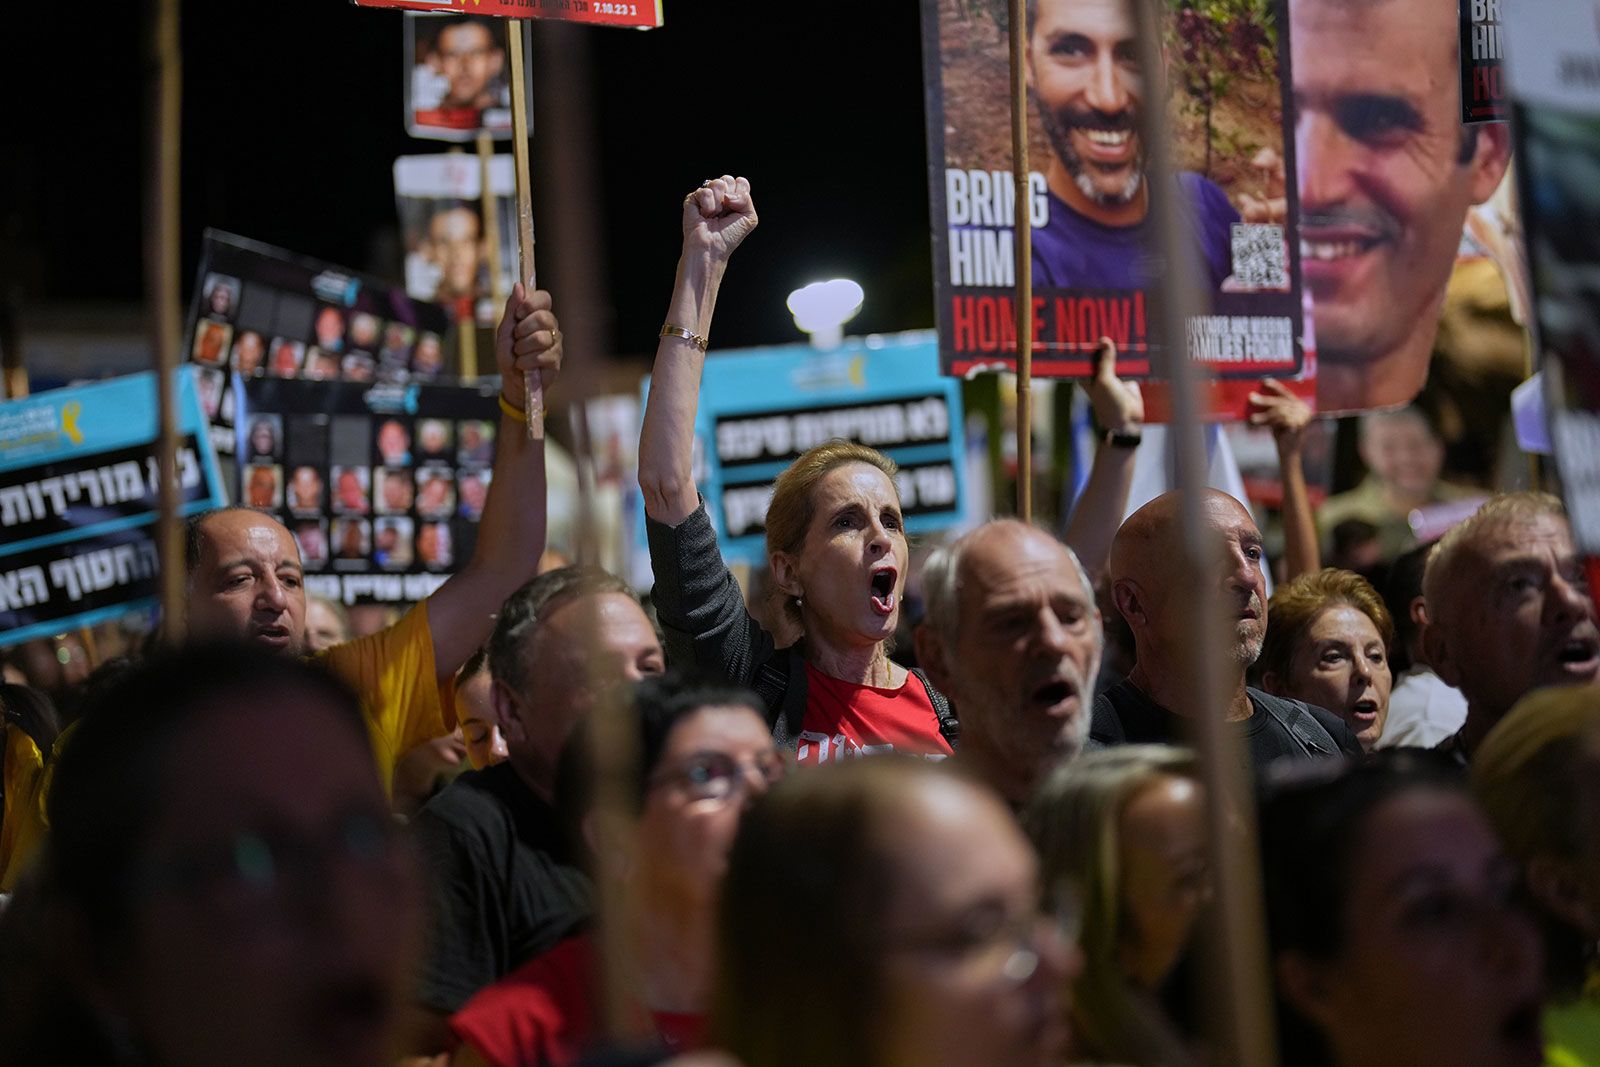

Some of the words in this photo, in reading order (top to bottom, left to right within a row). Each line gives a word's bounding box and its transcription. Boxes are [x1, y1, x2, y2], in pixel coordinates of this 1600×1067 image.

[1471, 0, 1502, 21] BR
[1472, 25, 1504, 59] HI
[1473, 66, 1505, 99] HO
[948, 230, 1016, 287] HIM
[1055, 290, 1147, 353] NOW!
[0, 459, 147, 527] מורידות
[0, 565, 49, 612] הא
[50, 538, 160, 602] החטוף
